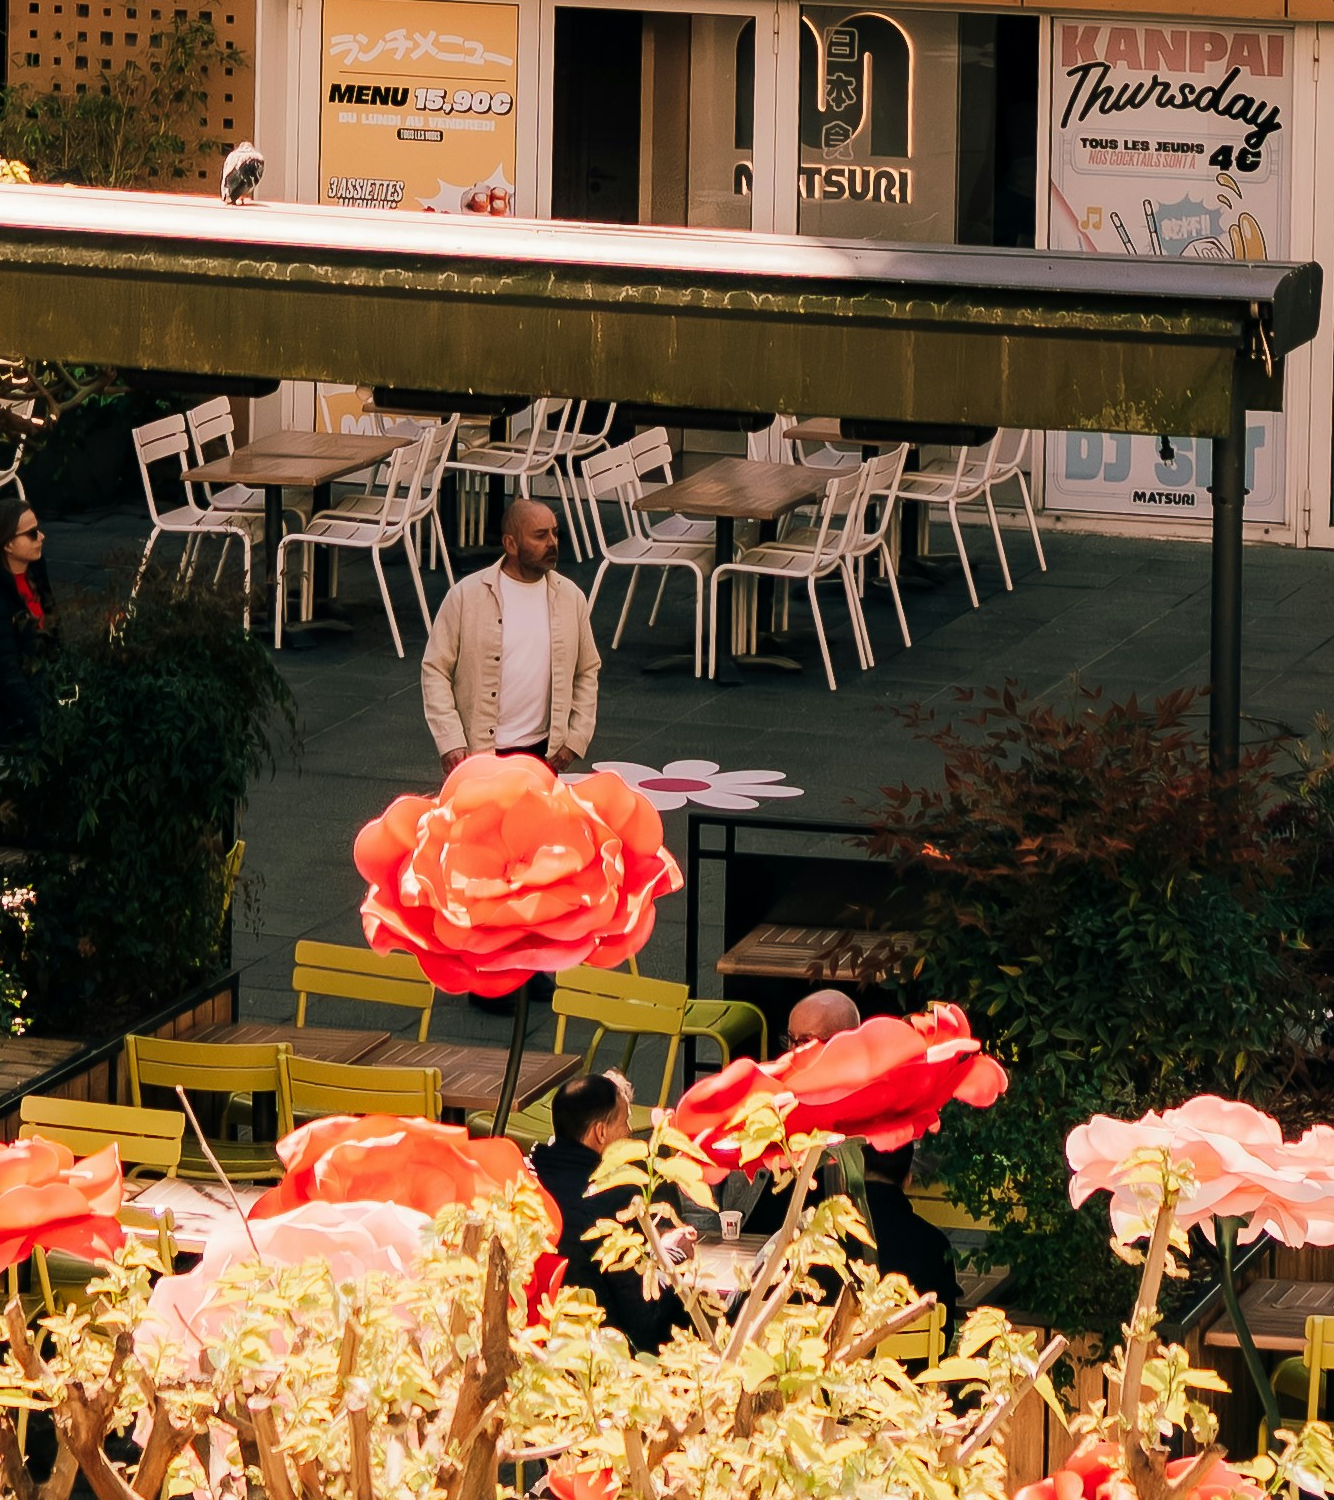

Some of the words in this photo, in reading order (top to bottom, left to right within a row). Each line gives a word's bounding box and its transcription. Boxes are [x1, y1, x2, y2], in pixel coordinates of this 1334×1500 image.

[329, 28, 513, 67] ランチメニュー
[1062, 25, 1285, 77] KANPAI
[329, 83, 409, 107] MENU
[1060, 61, 1283, 149] Thursday
[338, 112, 357, 123] DU
[361, 112, 401, 126] LUNDI
[405, 115, 424, 127] AU
[428, 117, 495, 131] VENDREDI
[1080, 138, 1119, 150] TOUS
[1124, 139, 1150, 152] LES
[1154, 141, 1205, 155] JEUDIS
[1088, 149, 1108, 166] NOS
[1109, 150, 1162, 168] COCKTAILS
[1163, 152, 1190, 169] SONT
[327, 177, 338, 198] 3
[340, 178, 405, 201] ASSIETTES
[733, 160, 912, 205] MTSURI
[1065, 430, 1131, 483] DJ
[1133, 491, 1195, 506] MATSURI
